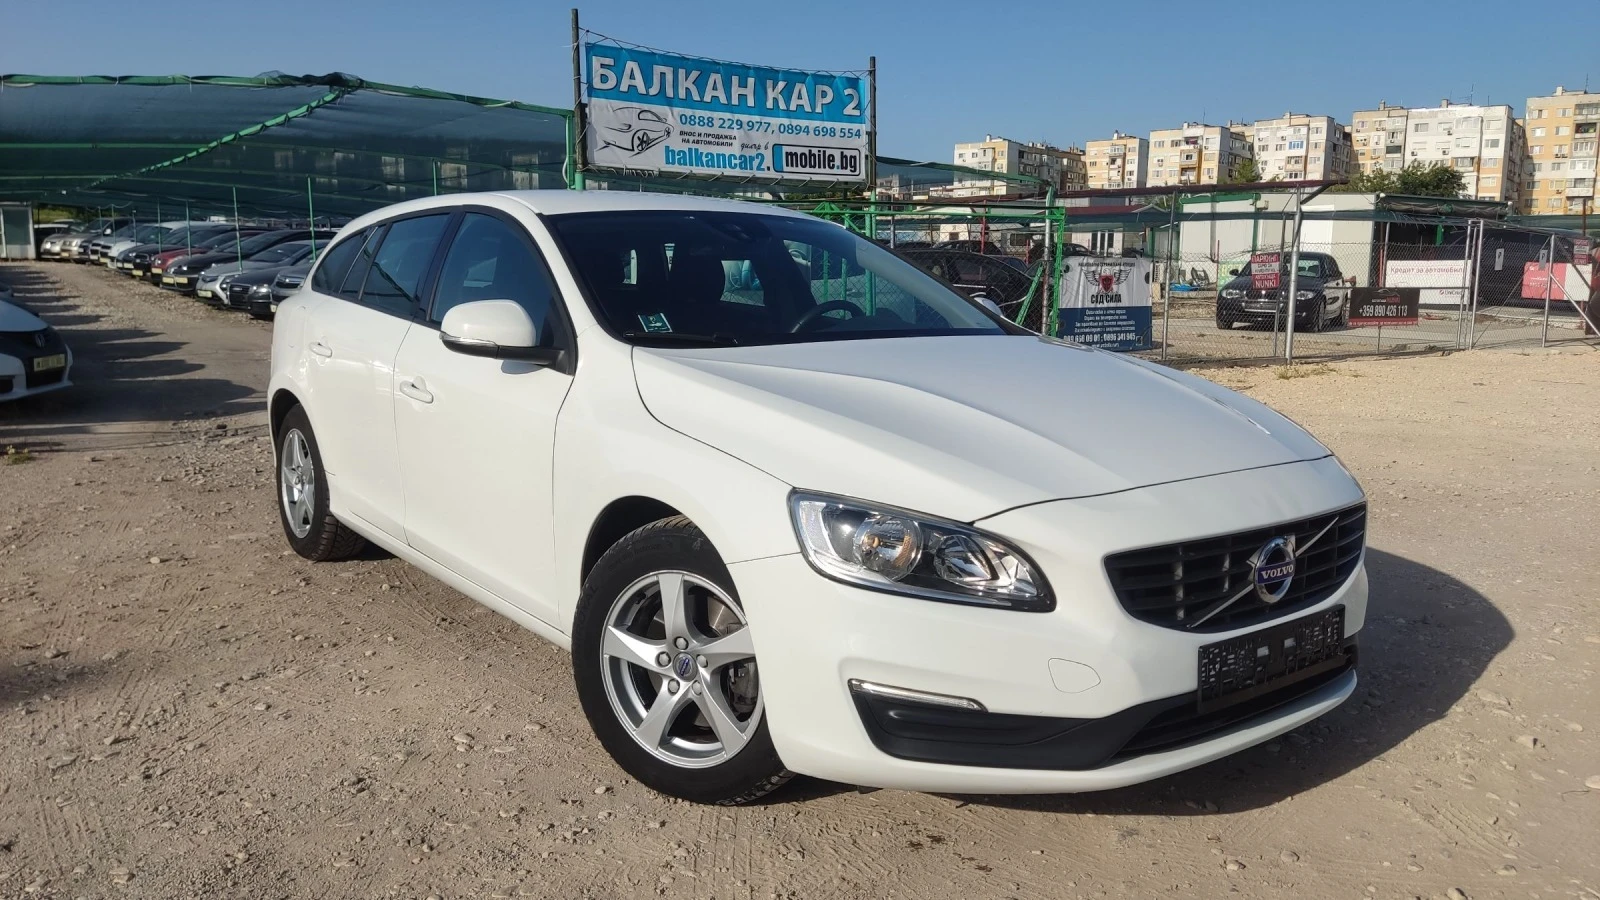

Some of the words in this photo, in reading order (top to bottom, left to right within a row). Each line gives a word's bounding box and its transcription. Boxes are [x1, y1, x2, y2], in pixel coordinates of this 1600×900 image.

[592, 55, 756, 107] БАЛКАН
[766, 78, 834, 113] КАР
[842, 88, 862, 116] 2
[679, 113, 715, 128] 0888
[718, 117, 743, 130] 229
[746, 120, 775, 134] 977,
[778, 123, 810, 136] 0894
[813, 126, 836, 137] 698
[839, 127, 861, 139] 554
[691, 139, 733, 147] АВТОМОБИЛИ
[785, 149, 857, 173] mobile.bg
[1390, 266, 1414, 274] Кредит
[1255, 279, 1276, 288] NUNKI
[1359, 305, 1373, 316] +359
[1374, 305, 1386, 316] 890
[1398, 304, 1408, 316] 113
[1260, 563, 1294, 580] VOLVO
